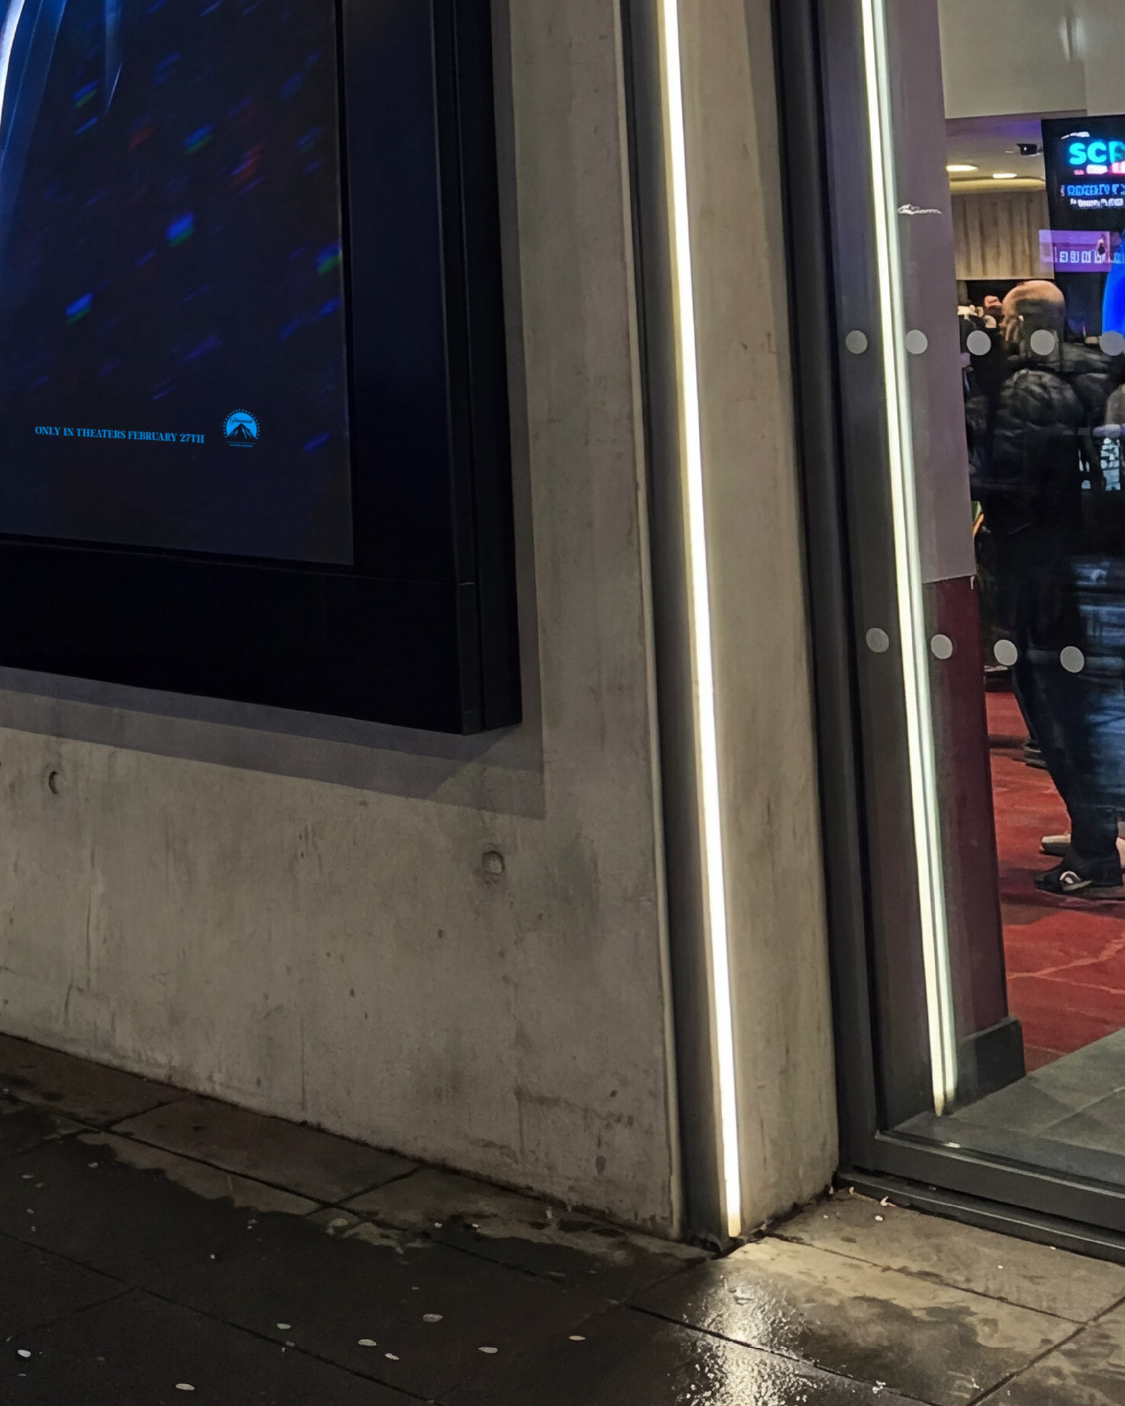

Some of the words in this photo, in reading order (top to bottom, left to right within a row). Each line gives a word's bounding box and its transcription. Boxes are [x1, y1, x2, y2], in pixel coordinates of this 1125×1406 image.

[34, 425, 62, 437] ONLY
[63, 427, 75, 438] IN
[75, 427, 127, 440] THEATERS
[127, 430, 179, 443] FEBRUARY
[179, 433, 206, 444] 27TH
